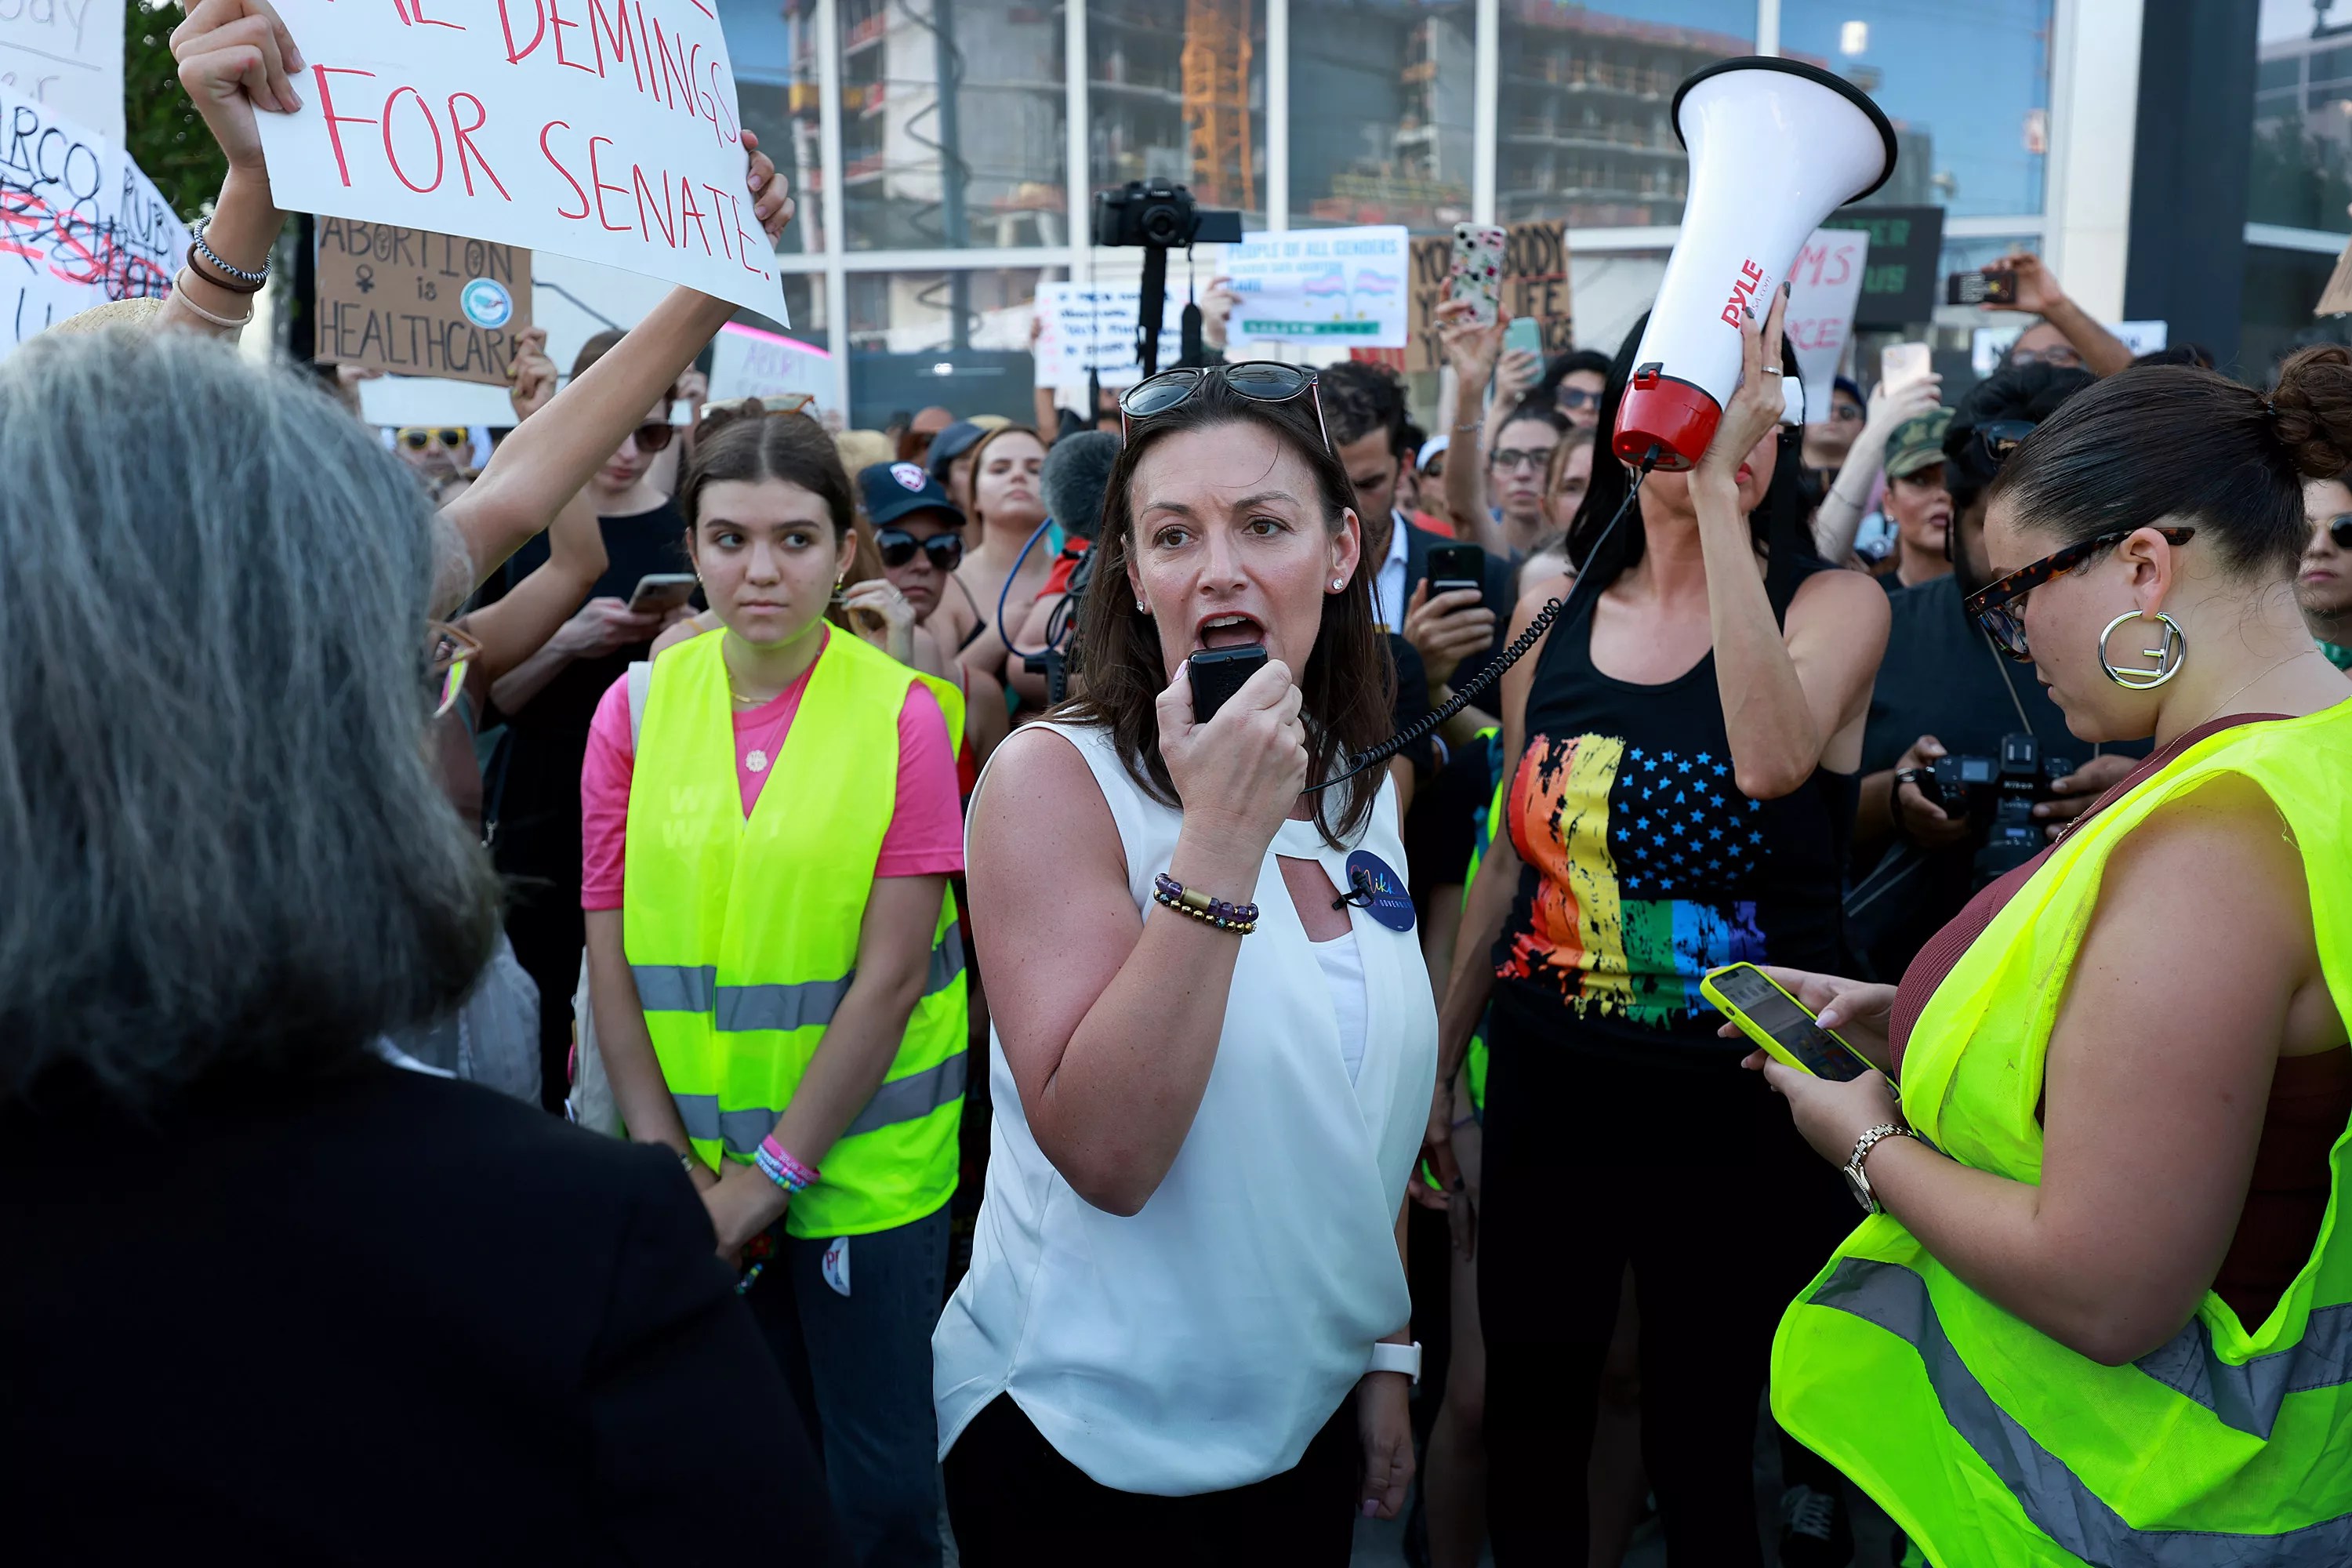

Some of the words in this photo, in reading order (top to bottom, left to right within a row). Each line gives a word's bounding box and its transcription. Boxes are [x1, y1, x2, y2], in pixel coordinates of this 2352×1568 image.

[499, 0, 739, 147] DEMINGS
[0, 97, 100, 200] RCO
[312, 64, 512, 202] FOR
[539, 120, 771, 281] SENATE.
[319, 215, 514, 285] ABORTION
[416, 276, 437, 301] is
